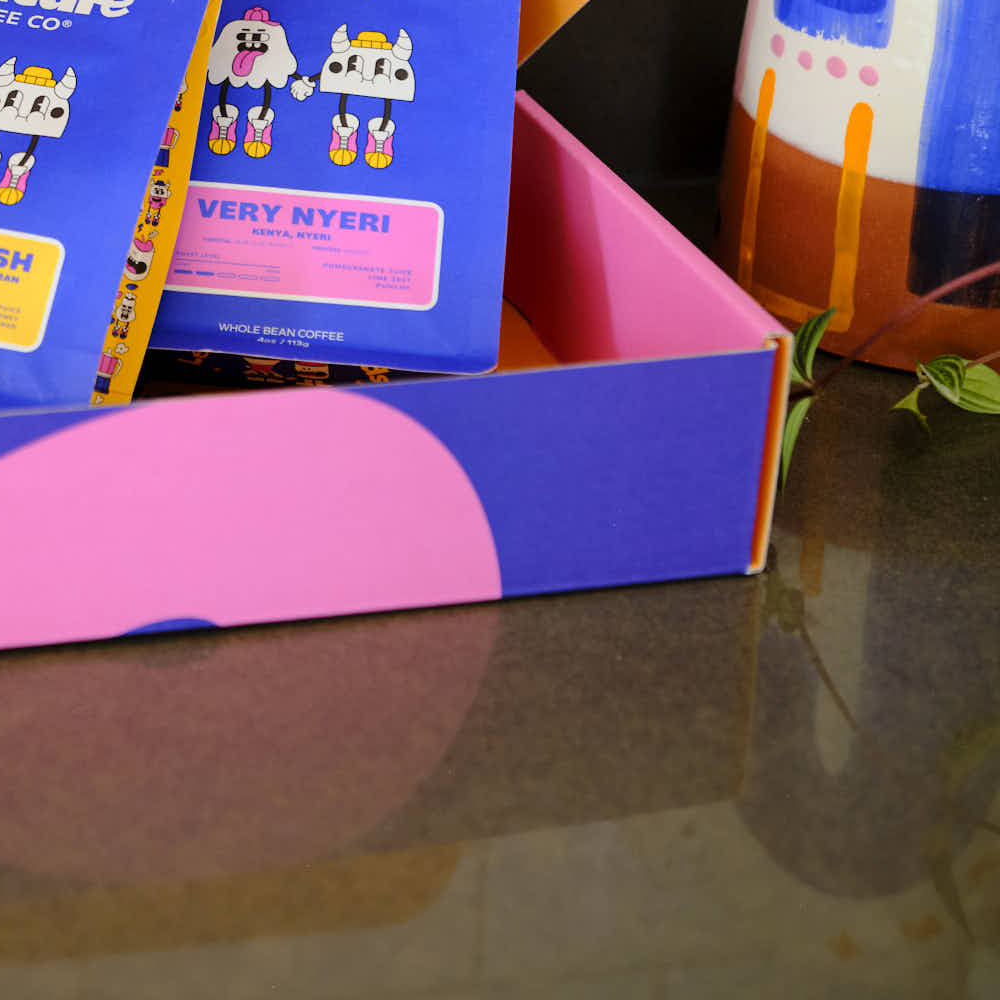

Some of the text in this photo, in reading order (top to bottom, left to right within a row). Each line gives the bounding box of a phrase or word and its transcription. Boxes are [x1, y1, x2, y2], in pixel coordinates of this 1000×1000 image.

[198, 198, 391, 233] VERY NYERI
[296, 231, 332, 241] NYERI
[218, 322, 345, 342] WHOLE BEAN COFFEE
